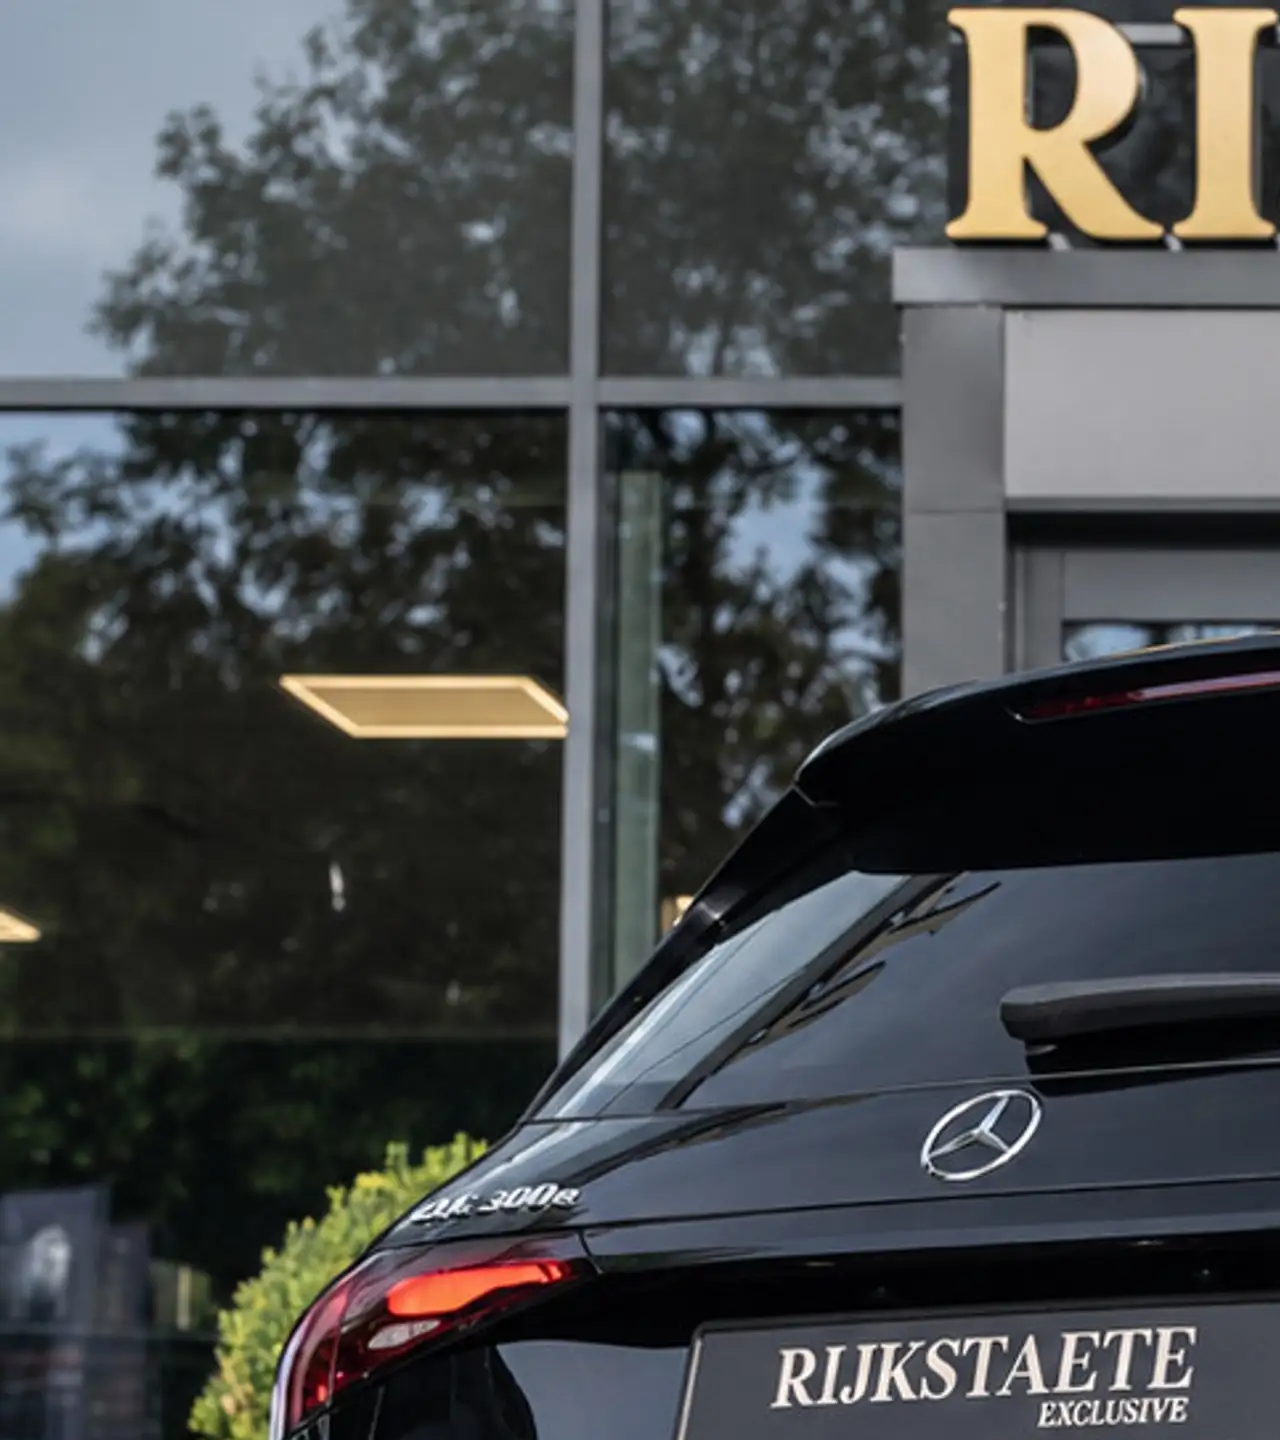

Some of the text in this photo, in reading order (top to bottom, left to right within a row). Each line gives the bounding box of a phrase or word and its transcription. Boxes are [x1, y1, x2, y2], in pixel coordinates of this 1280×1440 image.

[478, 1182, 581, 1212] 300e
[770, 1325, 1198, 1410] RIJKSTAETE
[1037, 1398, 1190, 1429] EXCLUSIVE
